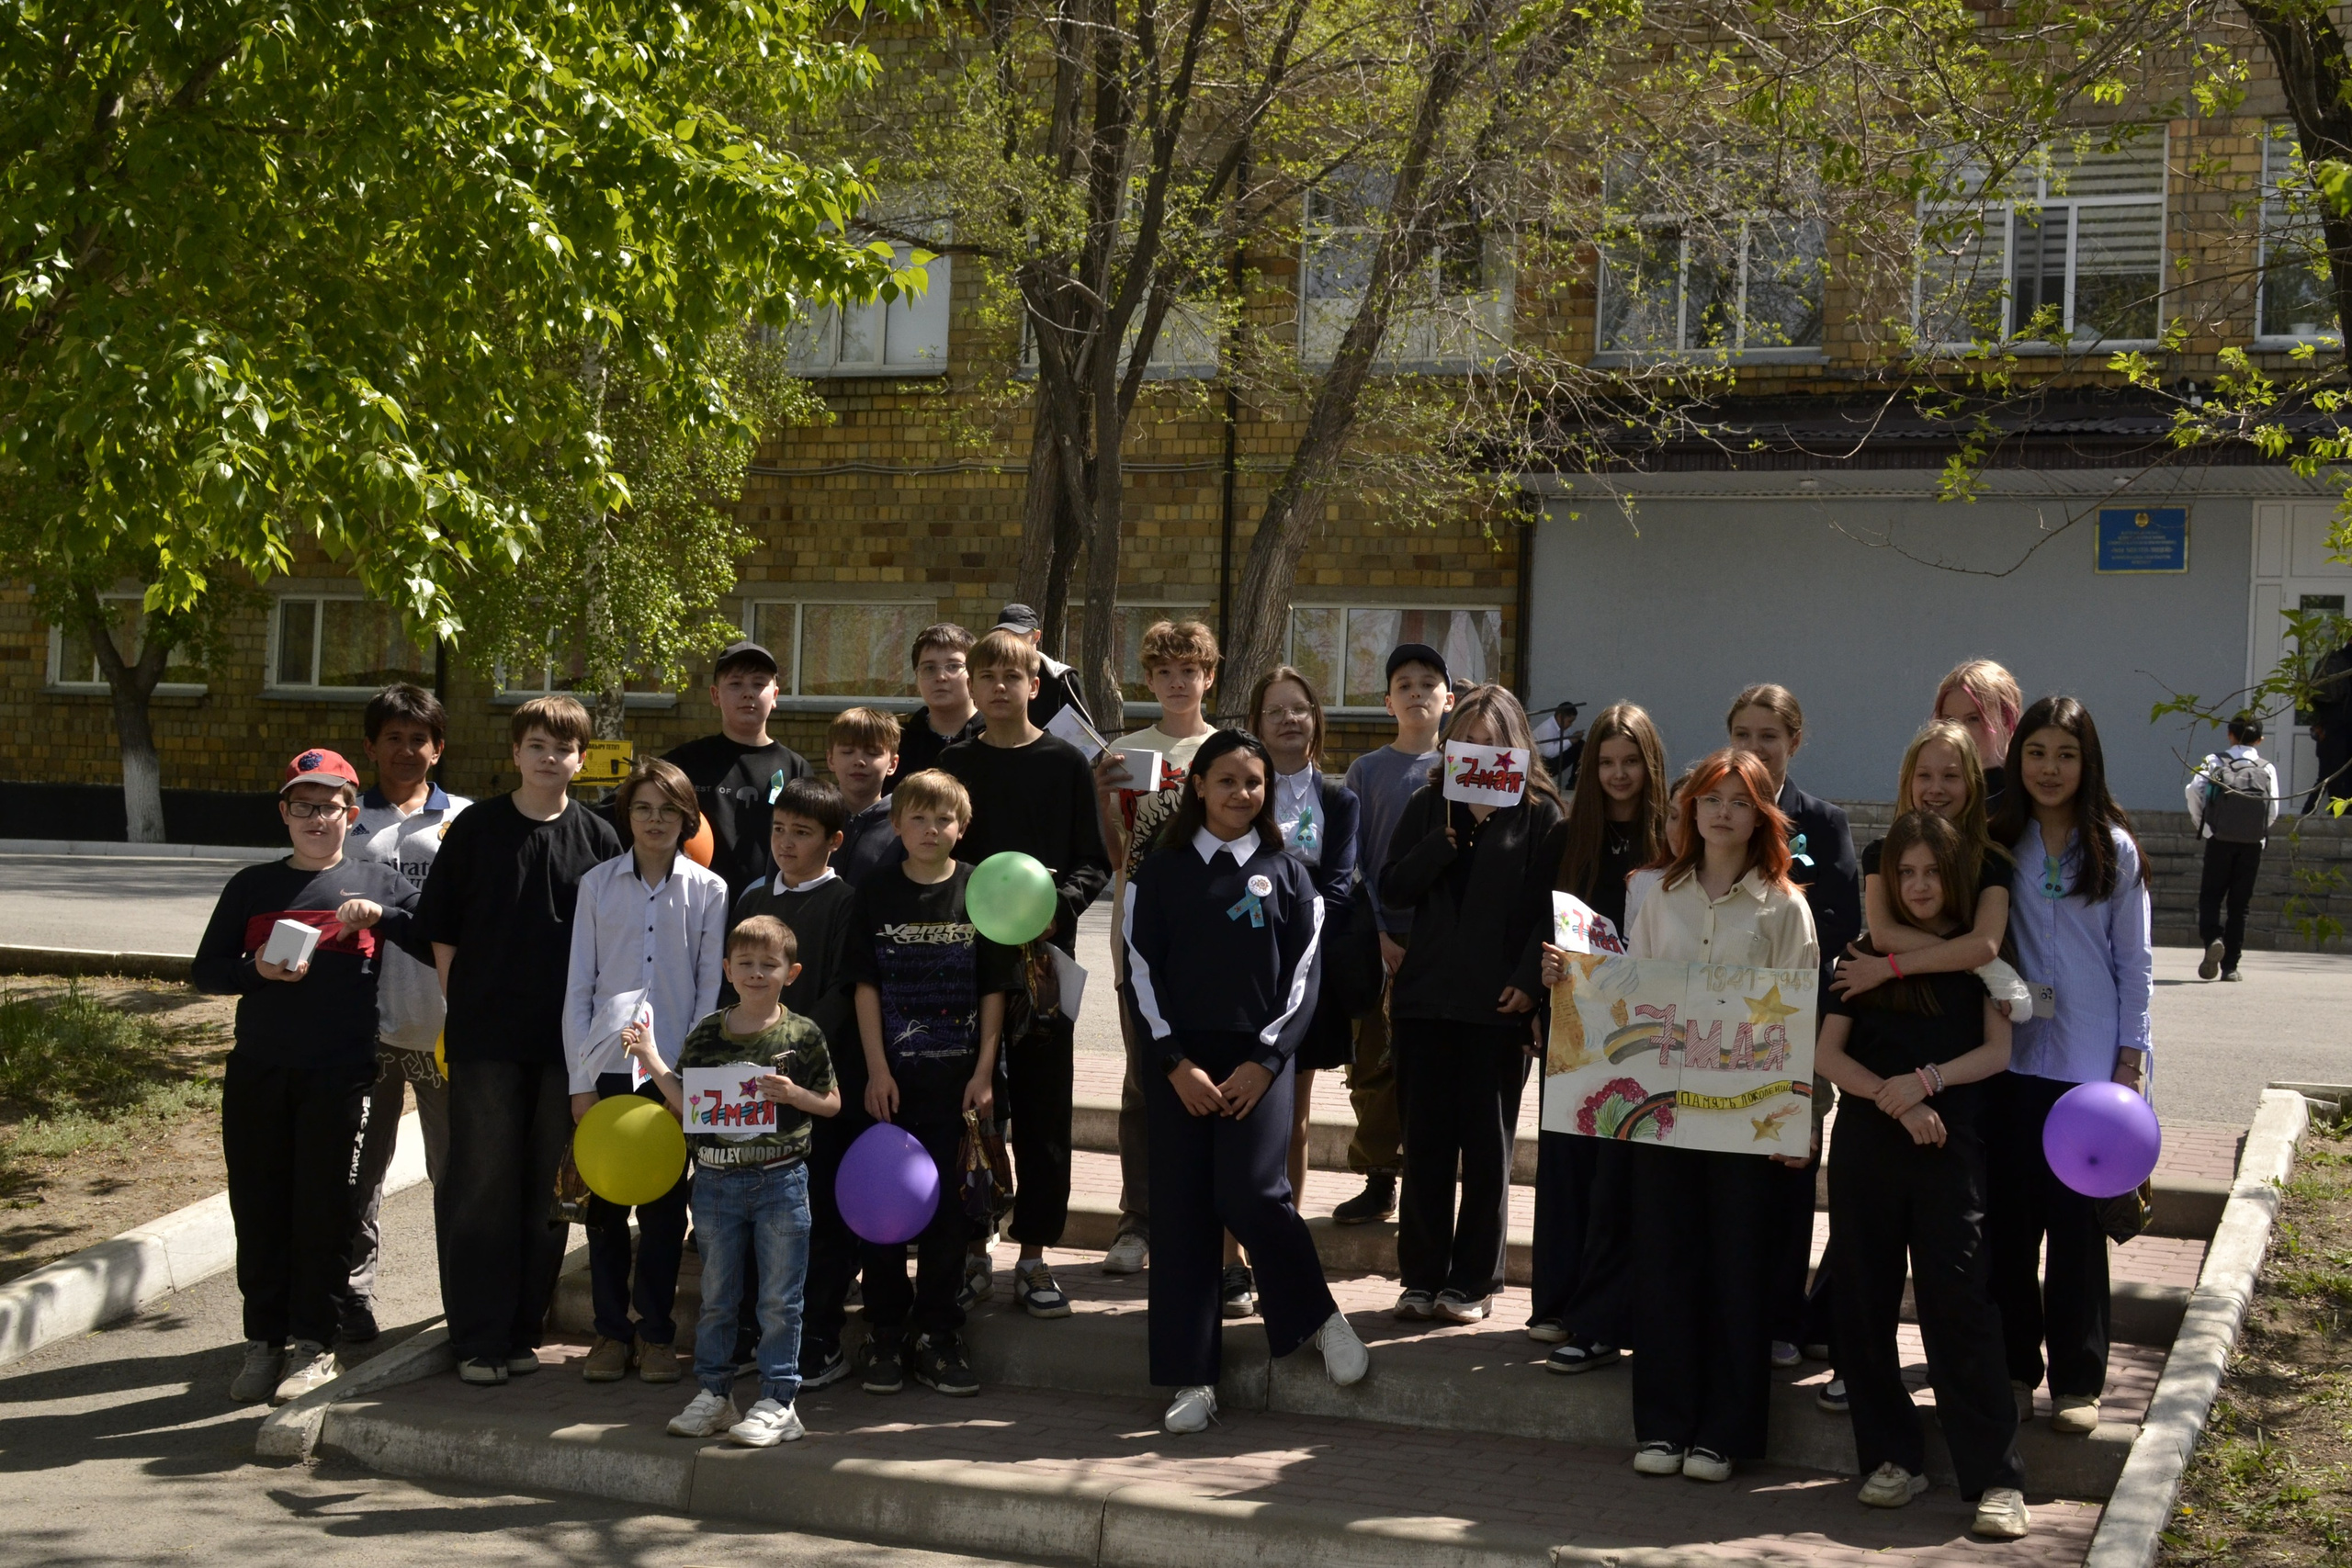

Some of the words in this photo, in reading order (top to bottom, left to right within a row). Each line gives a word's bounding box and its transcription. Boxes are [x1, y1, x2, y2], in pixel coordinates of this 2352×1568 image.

[695, 784, 712, 793] EST
[718, 786, 732, 795] OF
[1462, 756, 1479, 787] 7
[1477, 769, 1521, 794] мая
[1572, 908, 1585, 941] 7
[1634, 1003, 1677, 1065] 7
[1684, 1019, 1785, 1071] МАЯ
[704, 1089, 722, 1125] 7
[724, 1100, 775, 1126] мая
[1680, 1091, 1736, 1110] ПАМЯТЬ
[348, 1145, 362, 1186] START
